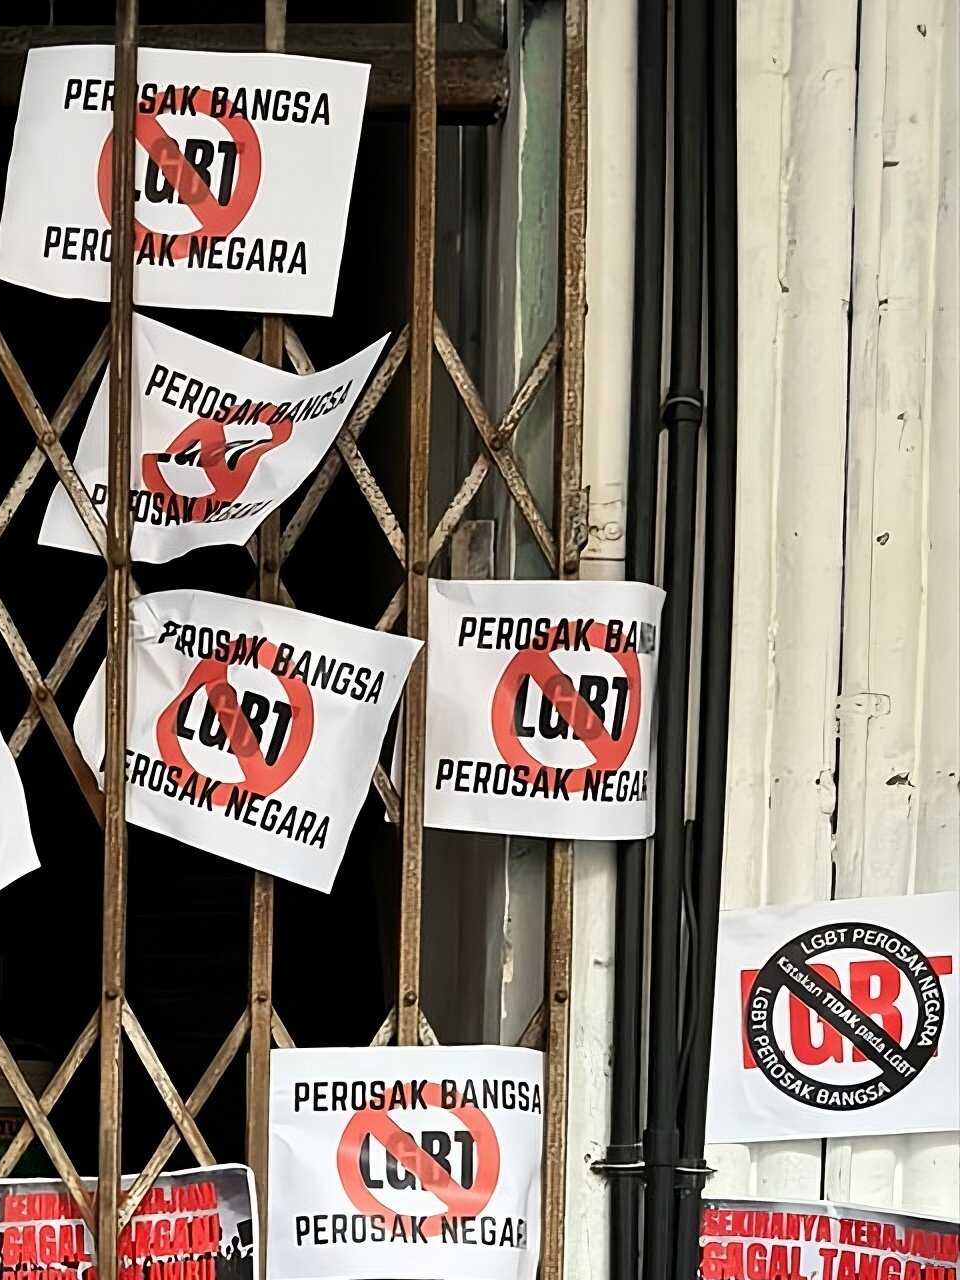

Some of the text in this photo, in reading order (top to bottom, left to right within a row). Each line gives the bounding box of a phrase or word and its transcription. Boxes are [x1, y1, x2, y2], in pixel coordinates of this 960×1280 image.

[64, 78, 330, 126] PERSAK BANGSA
[134, 138, 244, 206] GBT
[43, 226, 307, 275] PEROAK NEGARA
[145, 364, 354, 425] PEROSAK BANGSA
[458, 617, 593, 651] PEROSAK
[271, 643, 385, 704] BANGSA
[120, 749, 330, 849] EROSAK NEGARA
[436, 759, 571, 801] PEROSAK
[800, 928, 942, 1047] LGBT PEROSAK NEGARA
[776, 955, 917, 1078] Katakan TIDAK pada LGBT
[751, 986, 891, 1107] LGBT PEROSAK BANGSA
[294, 1079, 542, 1114] PEROSAK BANGSA
[2, 1213, 220, 1266] GAGAL ANGANI
[295, 1214, 429, 1246] PEROSAK
